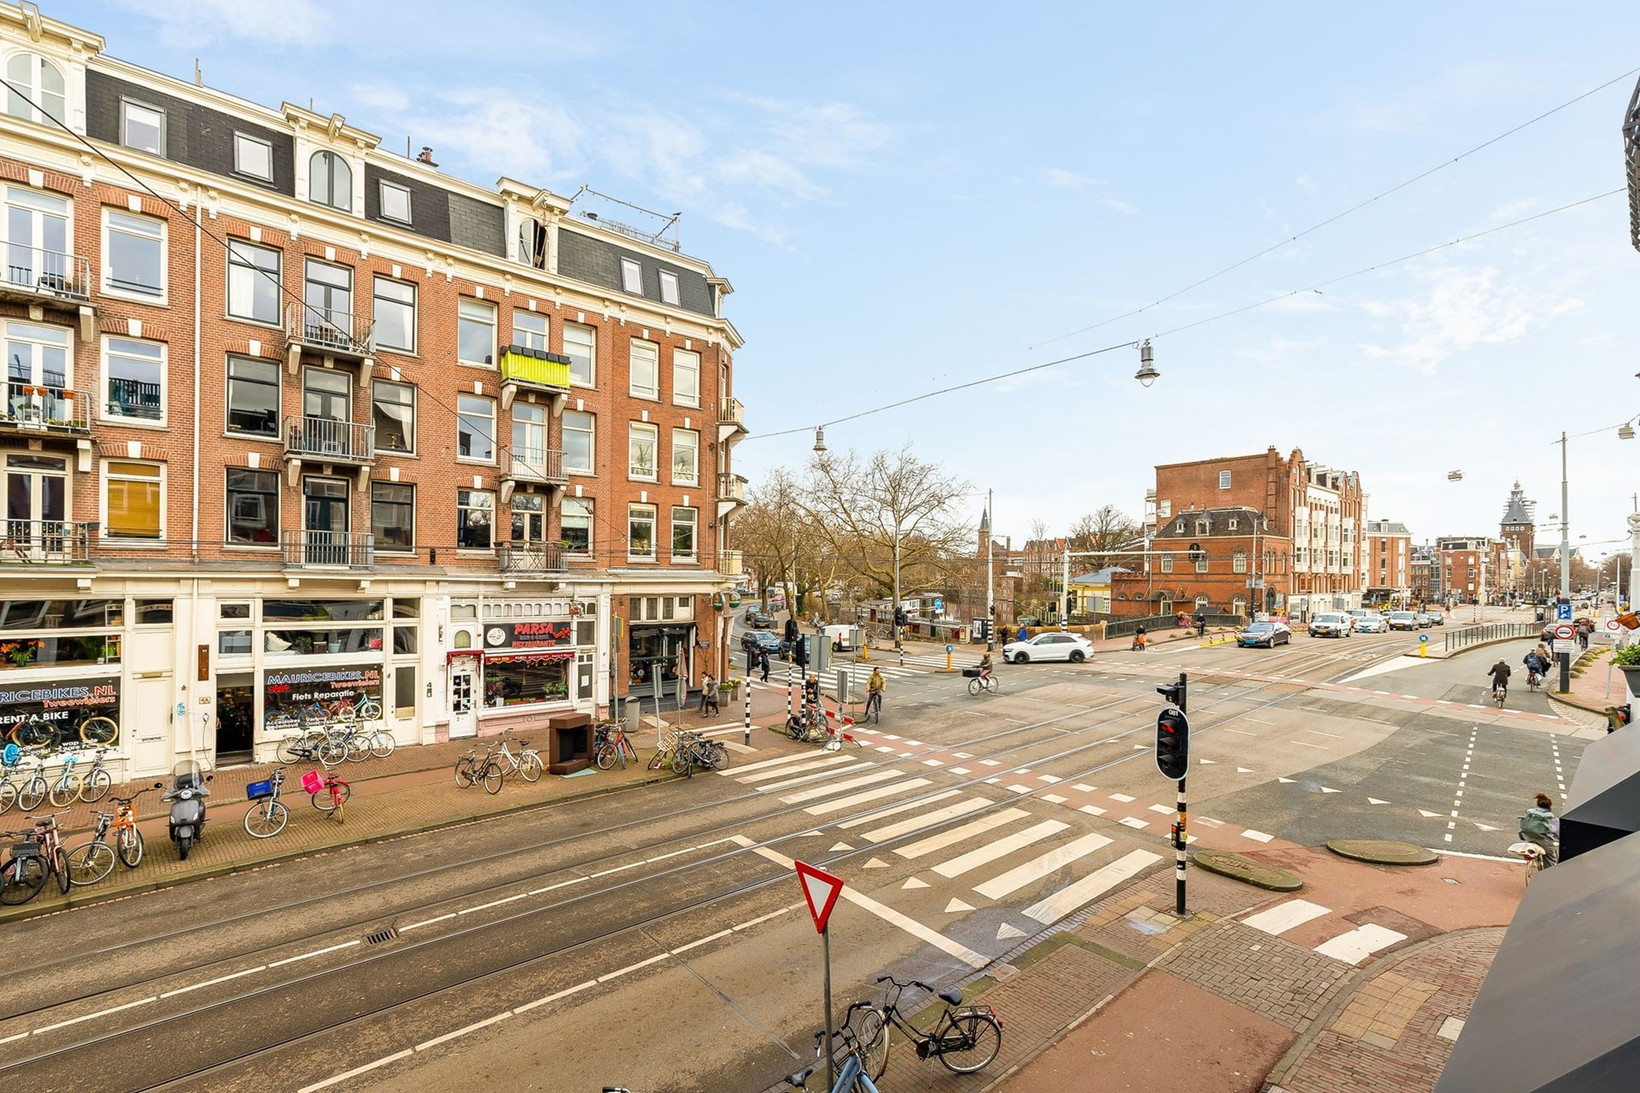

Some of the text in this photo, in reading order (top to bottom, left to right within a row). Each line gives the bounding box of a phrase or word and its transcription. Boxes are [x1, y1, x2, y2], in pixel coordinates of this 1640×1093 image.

[514, 622, 553, 634] PARSA
[267, 670, 380, 684] MAURICEBIKES.NL
[292, 689, 355, 701] Fiets Reparatie
[30, 713, 39, 722] A
[43, 711, 69, 721] BIKE
